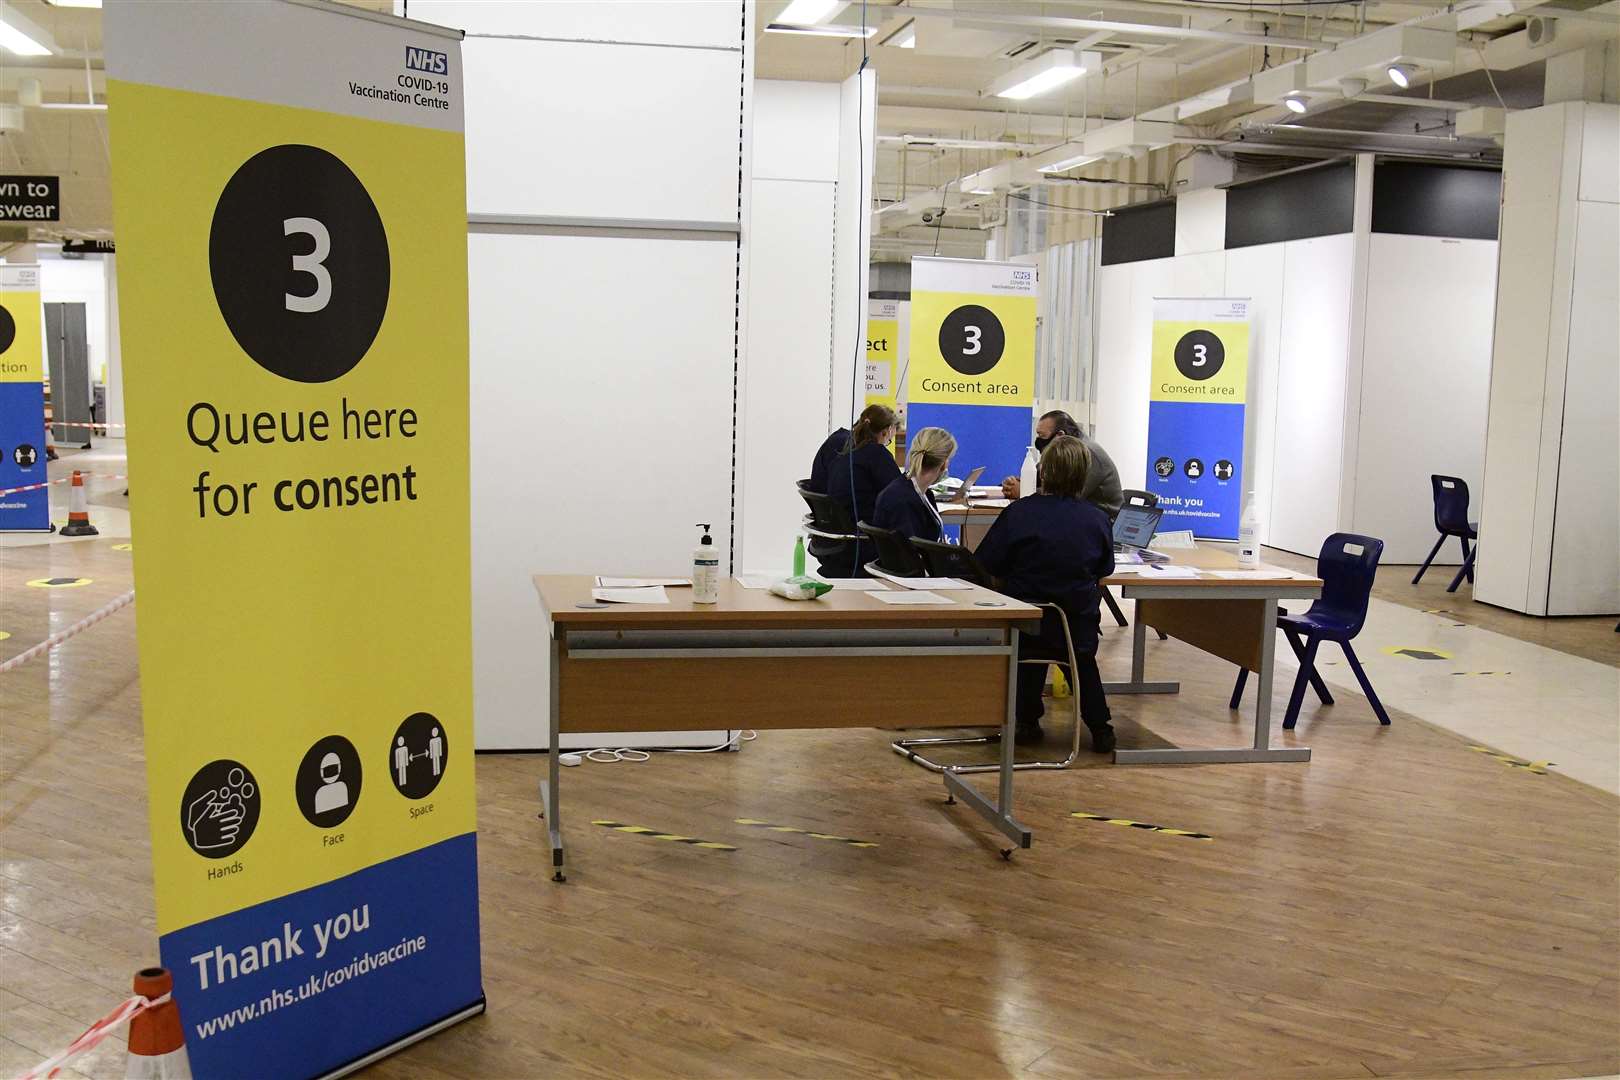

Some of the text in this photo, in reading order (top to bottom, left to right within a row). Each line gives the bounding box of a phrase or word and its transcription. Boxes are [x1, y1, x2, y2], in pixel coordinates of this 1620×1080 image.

[406, 48, 446, 74] NHS
[348, 81, 449, 110] Vaccination Centre
[397, 75, 449, 95] COVID-19
[27, 182, 49, 197] to
[283, 217, 332, 313] 3
[962, 325, 982, 355] 3
[1192, 344, 1207, 367] 3
[922, 378, 1018, 395] Consent area
[1161, 383, 1235, 395] Consent area
[187, 397, 418, 453] Queue here
[193, 465, 418, 518] for consent
[1155, 493, 1204, 508] hank you
[409, 803, 434, 819] Space
[323, 832, 345, 847] Face
[207, 860, 244, 880] Hands
[190, 903, 371, 990] Thank you
[195, 935, 427, 1039] www.nhs.uk/covidvaccine
